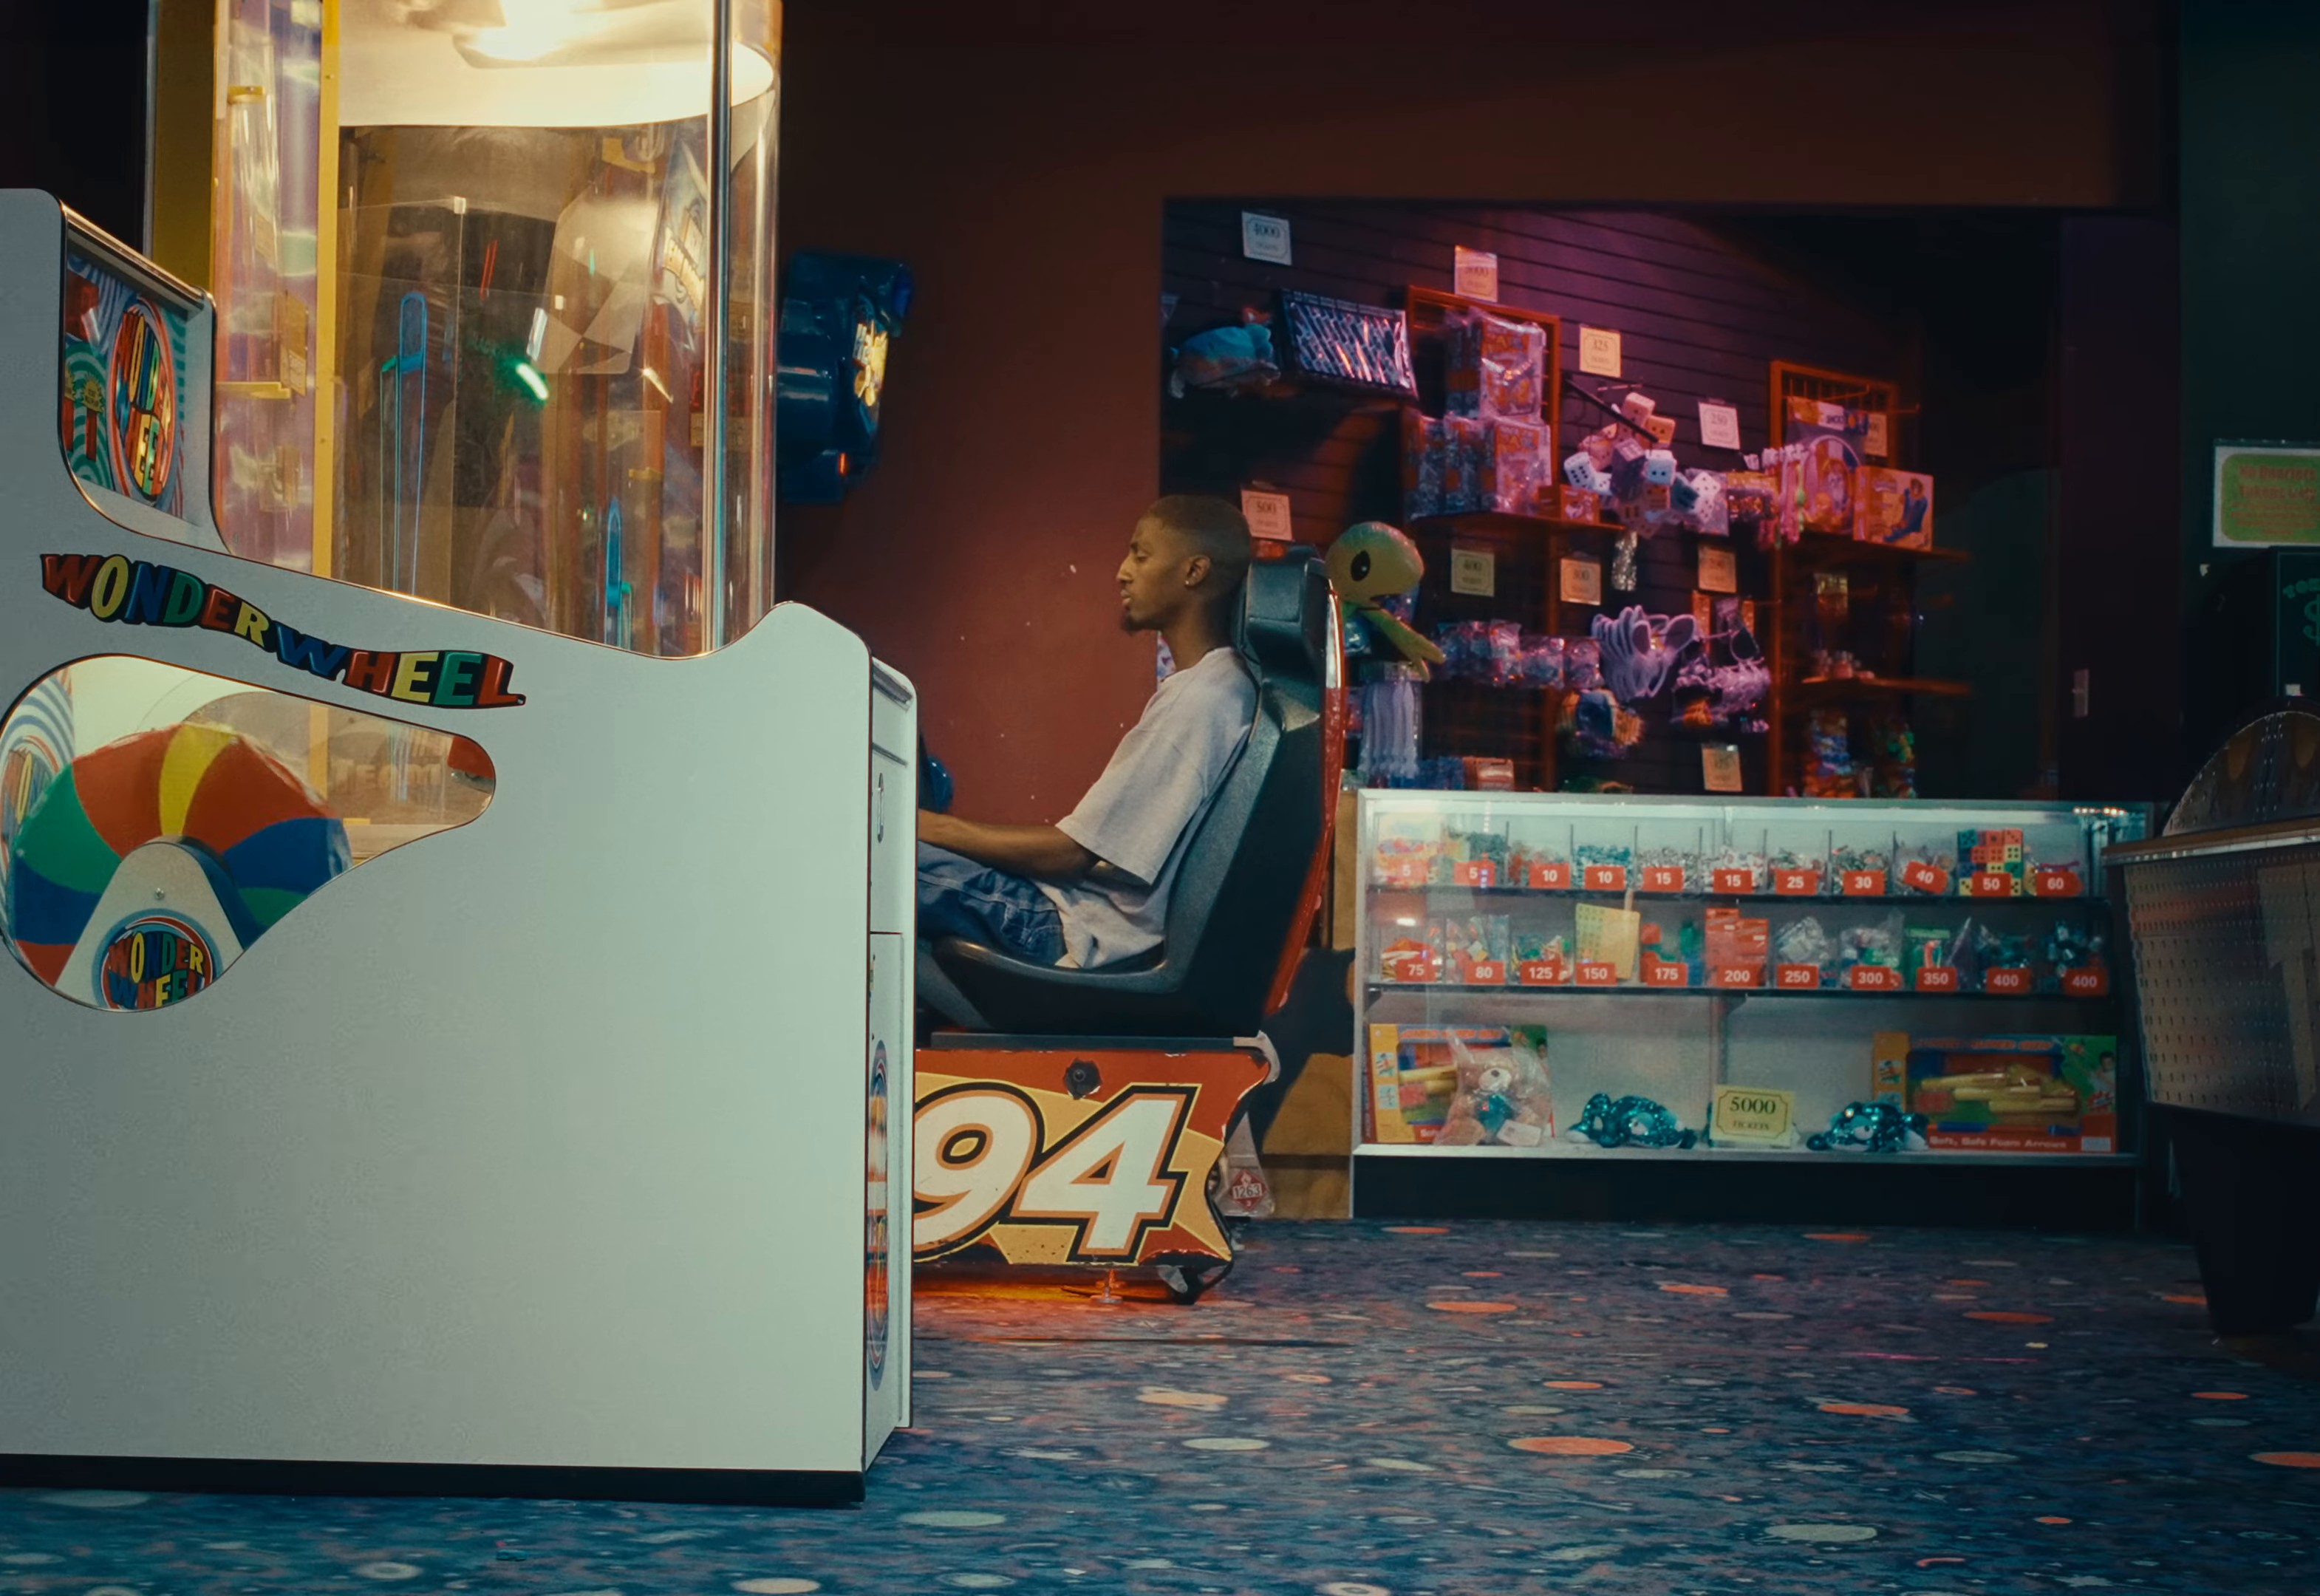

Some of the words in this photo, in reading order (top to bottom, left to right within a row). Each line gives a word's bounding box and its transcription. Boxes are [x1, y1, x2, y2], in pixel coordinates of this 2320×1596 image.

[41, 554, 270, 647] WONDER
[276, 621, 525, 708] WHEEL
[1402, 864, 1410, 876] 5
[1470, 867, 1478, 879] 5
[1542, 870, 1558, 882] 10
[1597, 871, 1613, 884] 10
[1656, 873, 1671, 884] 15
[1725, 874, 1741, 887] 15
[1787, 876, 1804, 889] 25
[1855, 876, 1872, 889] 30
[1917, 870, 1934, 884] 40
[1983, 878, 2000, 890] 50
[2047, 878, 2064, 890] 60
[108, 932, 205, 983] WONDER
[1408, 964, 1425, 976] 75
[1529, 967, 1552, 979] 125
[1583, 967, 1608, 980] 150
[1655, 968, 1678, 980] 175
[1724, 969, 1750, 982] 200
[1785, 971, 1810, 983] 250
[1858, 972, 1883, 984] 300
[1923, 972, 1948, 985] 350
[1993, 974, 2019, 986] 400
[2072, 975, 2098, 988] 400
[1730, 1097, 1776, 1114] 5000
[914, 1083, 1199, 1263] 94
[1235, 1184, 1260, 1198] 1263
